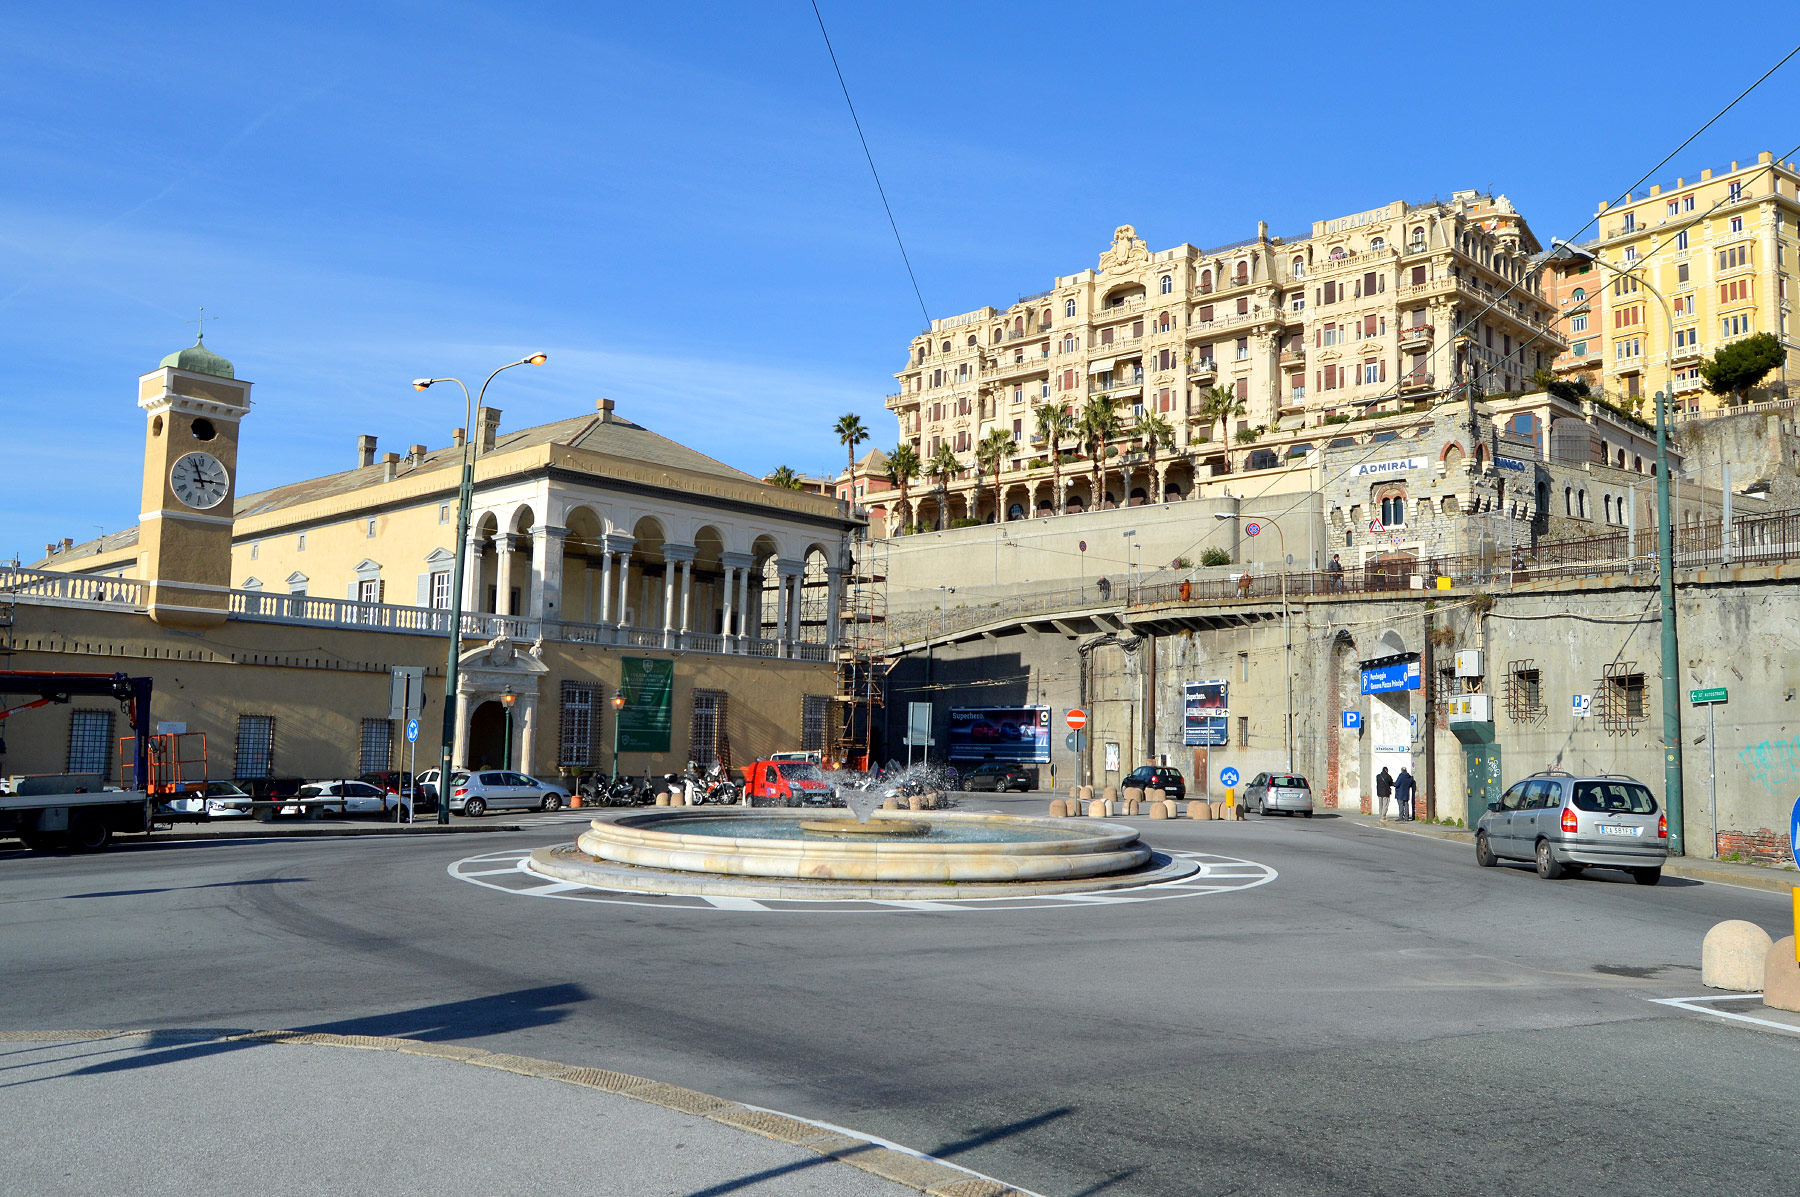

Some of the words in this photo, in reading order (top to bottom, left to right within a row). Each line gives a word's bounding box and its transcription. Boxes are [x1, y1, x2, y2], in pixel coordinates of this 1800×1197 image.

[1328, 207, 1390, 234] MIRAMARE
[942, 311, 982, 330] MIRAMARE
[1359, 459, 1418, 475] ADMIRAL
[1575, 696, 1580, 707] P
[952, 712, 985, 720] Superhero.
[1346, 712, 1357, 727] P
